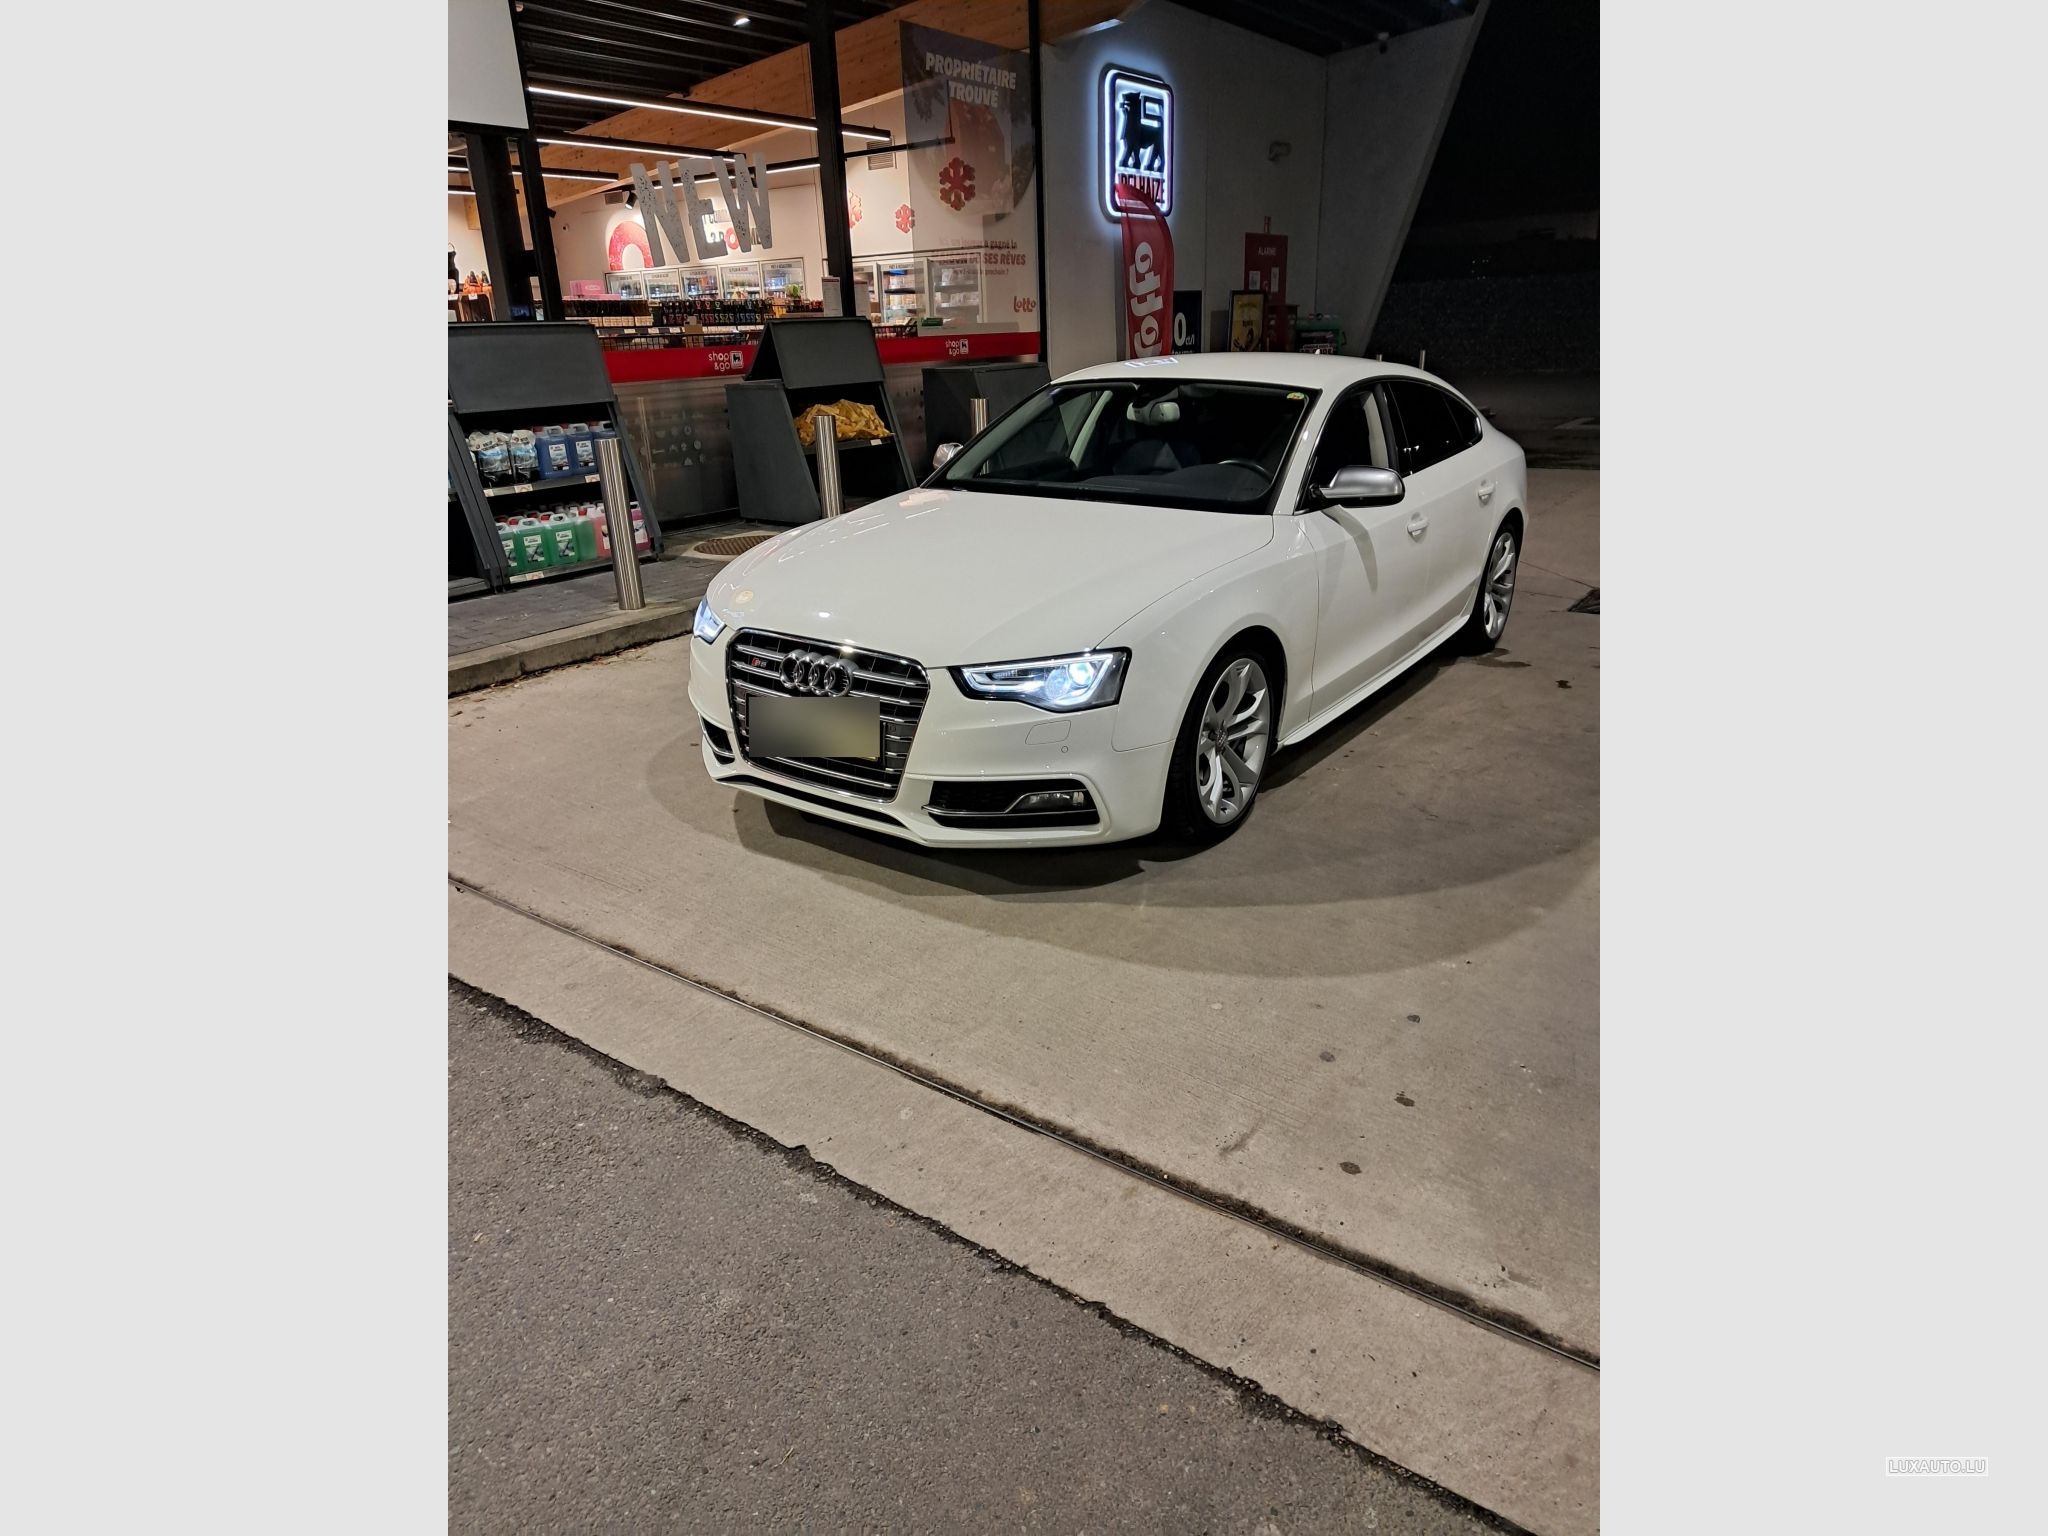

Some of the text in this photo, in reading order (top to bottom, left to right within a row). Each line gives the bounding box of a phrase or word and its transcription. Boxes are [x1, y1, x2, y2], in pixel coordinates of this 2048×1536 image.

[925, 51, 1017, 90] PROPRIÉTAIRE
[948, 81, 999, 108] TROUVÉ
[630, 152, 772, 267] NEW
[984, 252, 999, 265] SES
[1000, 250, 1026, 266] RÊVES
[708, 351, 729, 362] shop
[714, 362, 730, 372] &go
